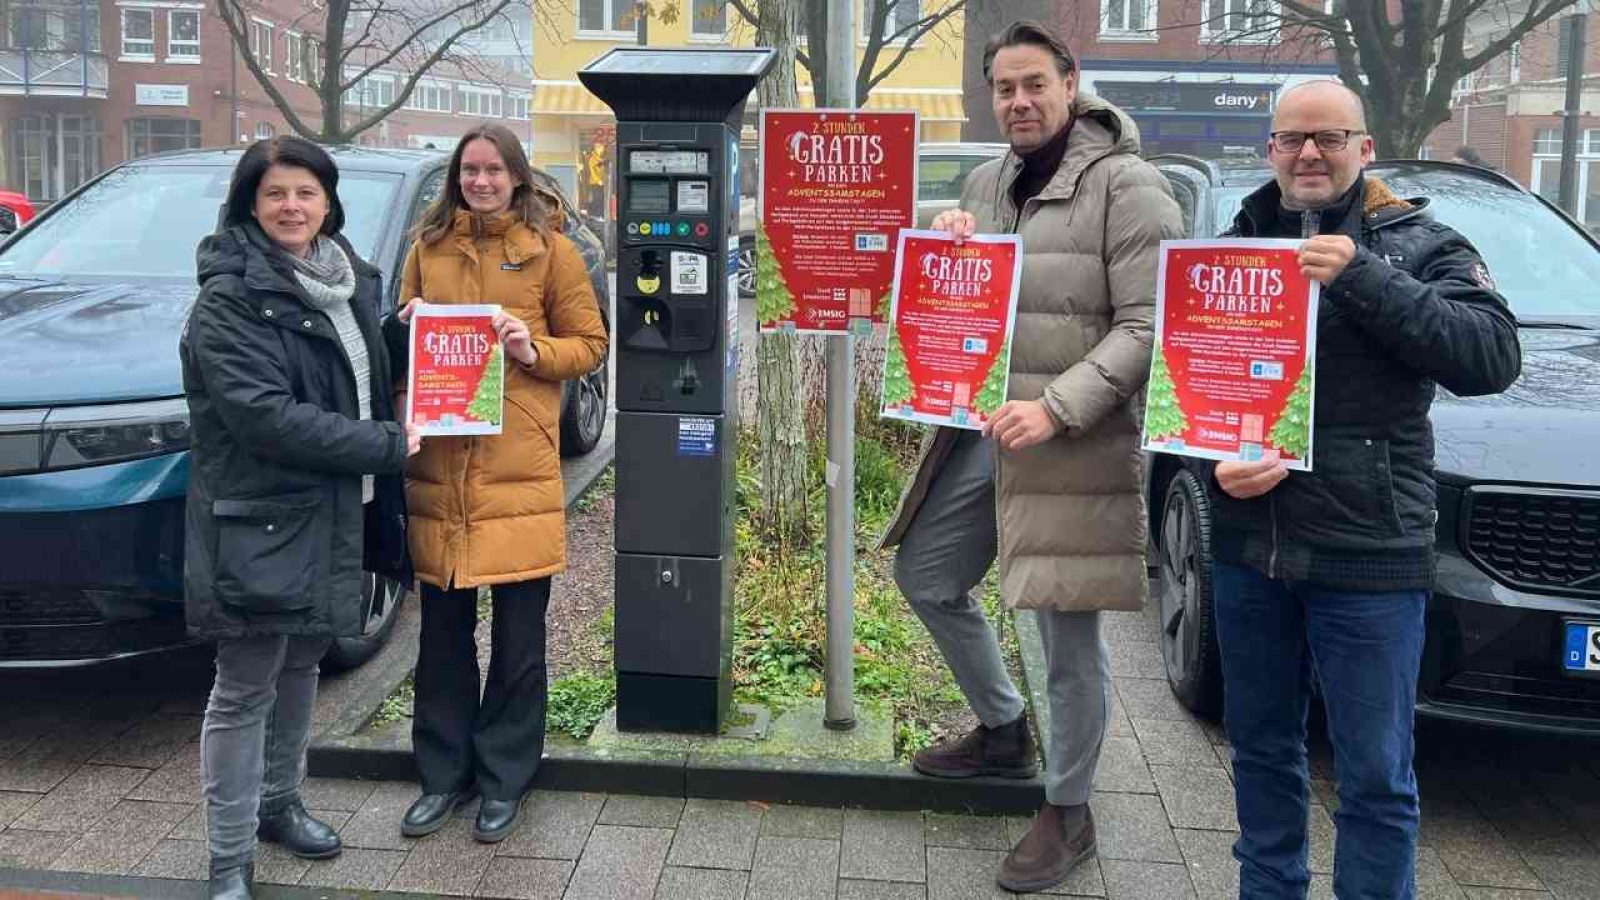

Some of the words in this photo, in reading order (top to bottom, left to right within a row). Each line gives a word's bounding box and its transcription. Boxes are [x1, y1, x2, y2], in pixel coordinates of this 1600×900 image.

[813, 122, 819, 135] 2
[822, 121, 866, 135] STUNDEN
[790, 131, 885, 165] GRATIS
[804, 164, 872, 183] PARKEN
[787, 188, 885, 199] ADVENTSSAMSTAGEN
[923, 252, 993, 282] GRATIS
[1224, 254, 1268, 267] STUNDEN
[932, 280, 981, 297] PARKEN
[1191, 263, 1284, 296] GRATIS
[1204, 294, 1272, 313] PARKEN
[424, 331, 489, 355] GRATIS
[434, 354, 482, 366] PARKEN
[1570, 650, 1580, 661] D
